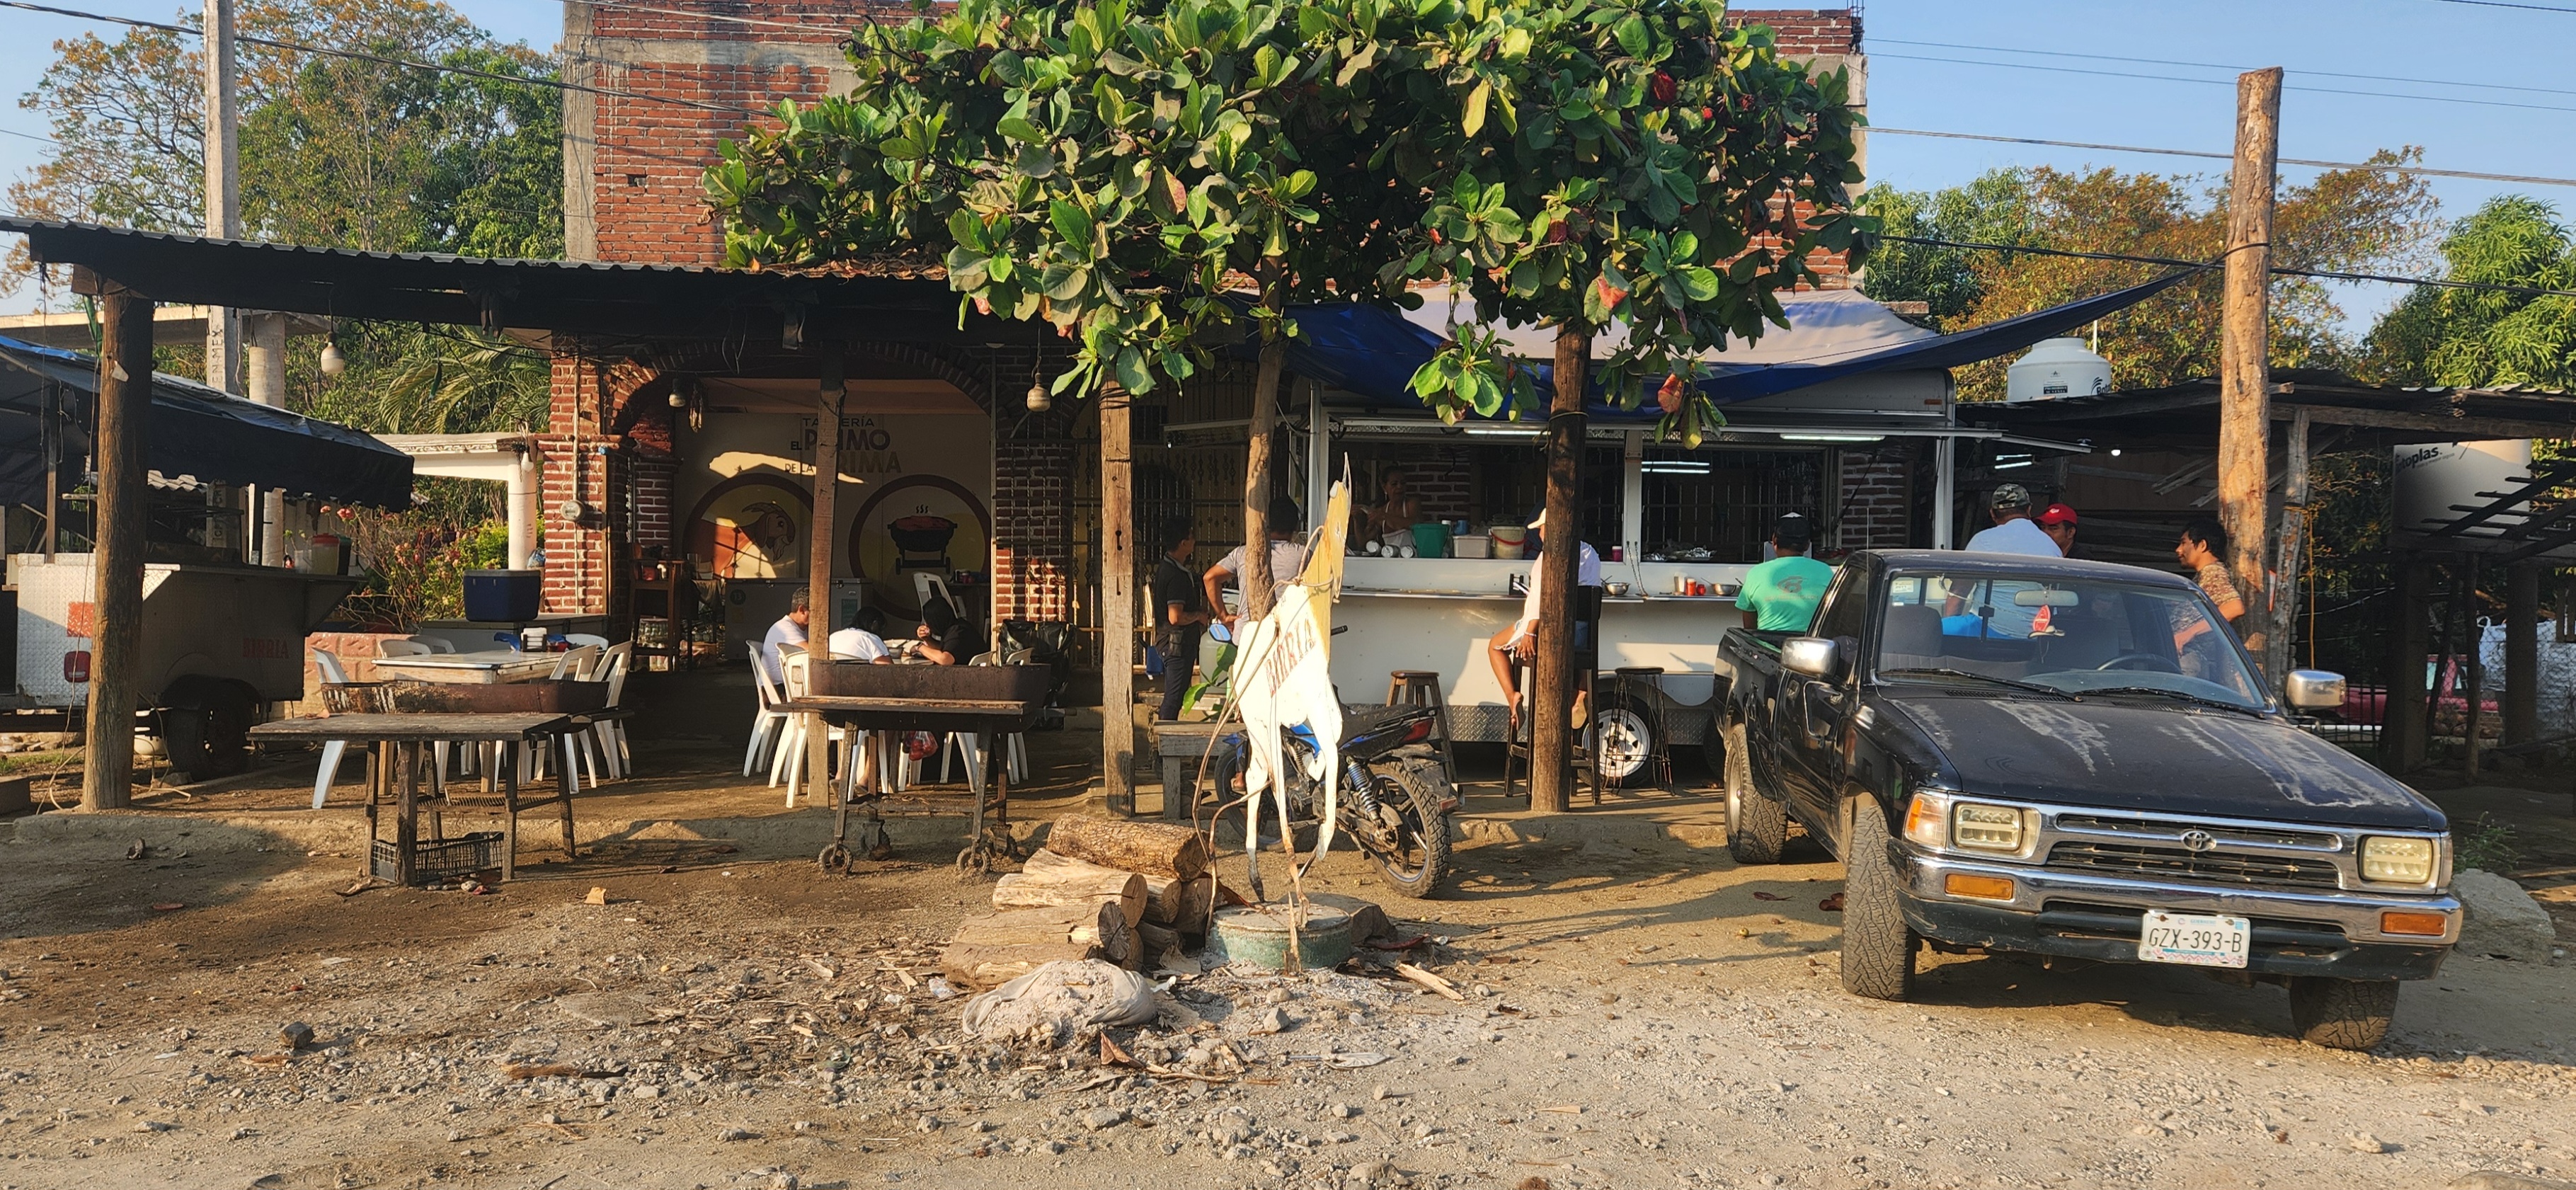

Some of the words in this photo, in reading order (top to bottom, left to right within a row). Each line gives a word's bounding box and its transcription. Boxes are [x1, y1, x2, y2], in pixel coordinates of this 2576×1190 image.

[803, 416, 875, 427] TAERÍA
[791, 441, 802, 450] EL
[784, 463, 796, 472] DE
[801, 464, 814, 472] LA
[2149, 928, 2242, 953] GZX-393-B
